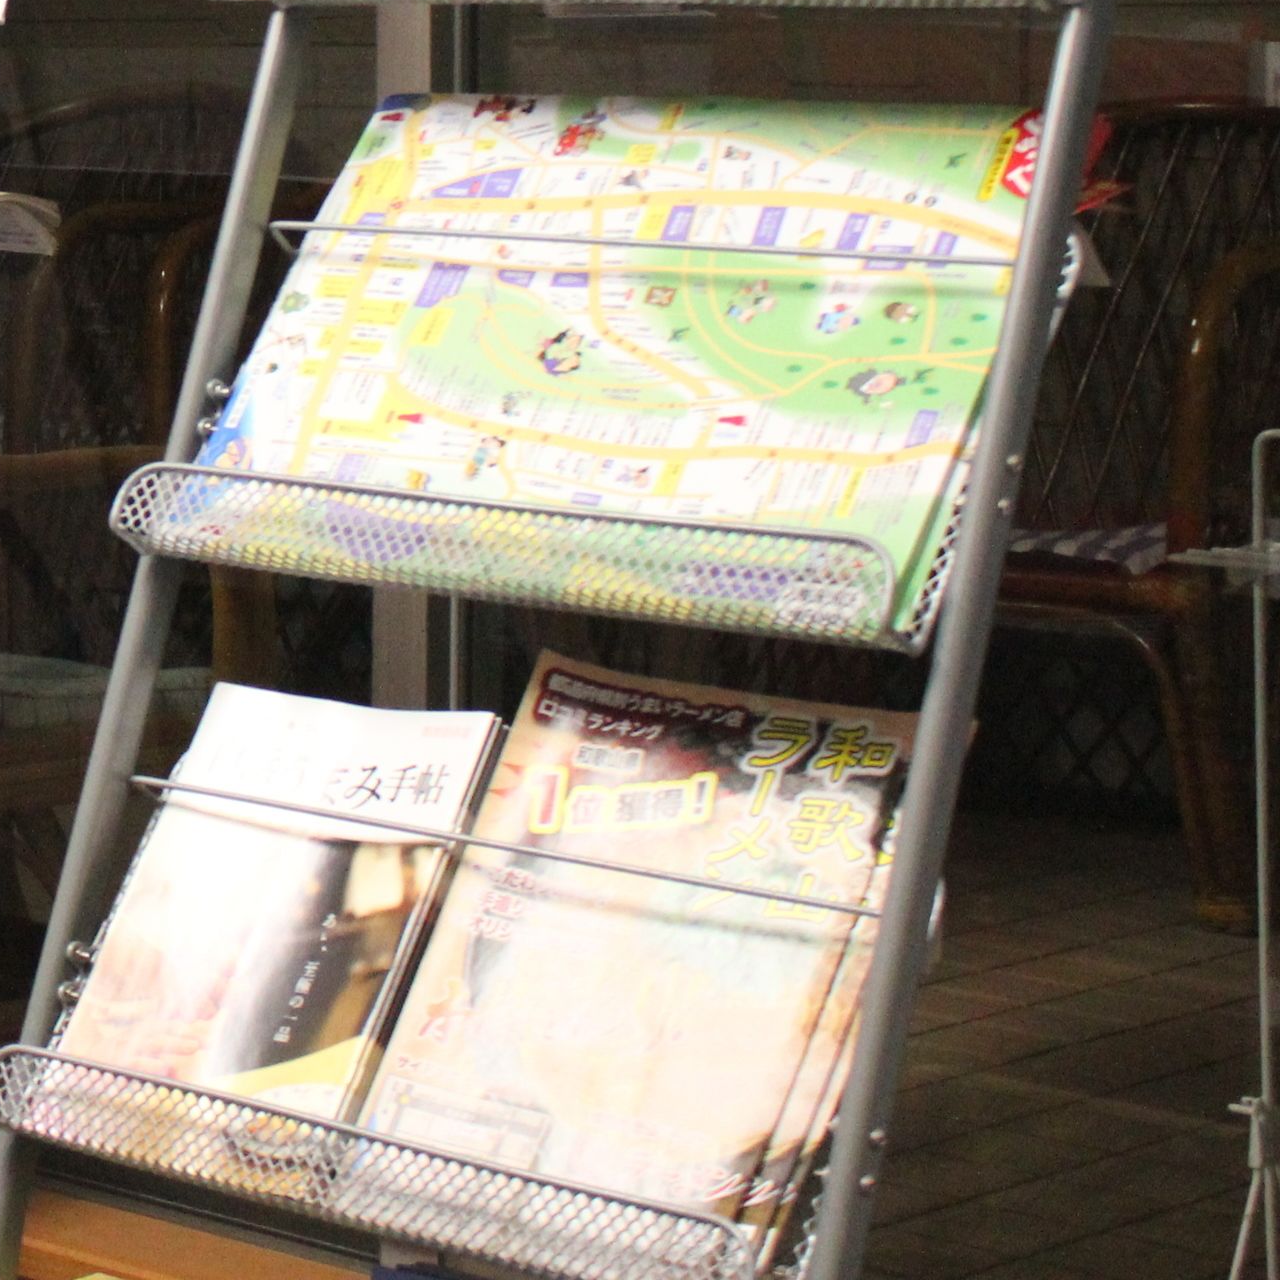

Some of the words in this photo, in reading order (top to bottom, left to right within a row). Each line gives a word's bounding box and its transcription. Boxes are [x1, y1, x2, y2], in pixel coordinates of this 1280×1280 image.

[539, 699, 666, 742] 口コミランキング
[690, 718, 813, 914] ラーメン
[763, 724, 896, 922] 和歌山
